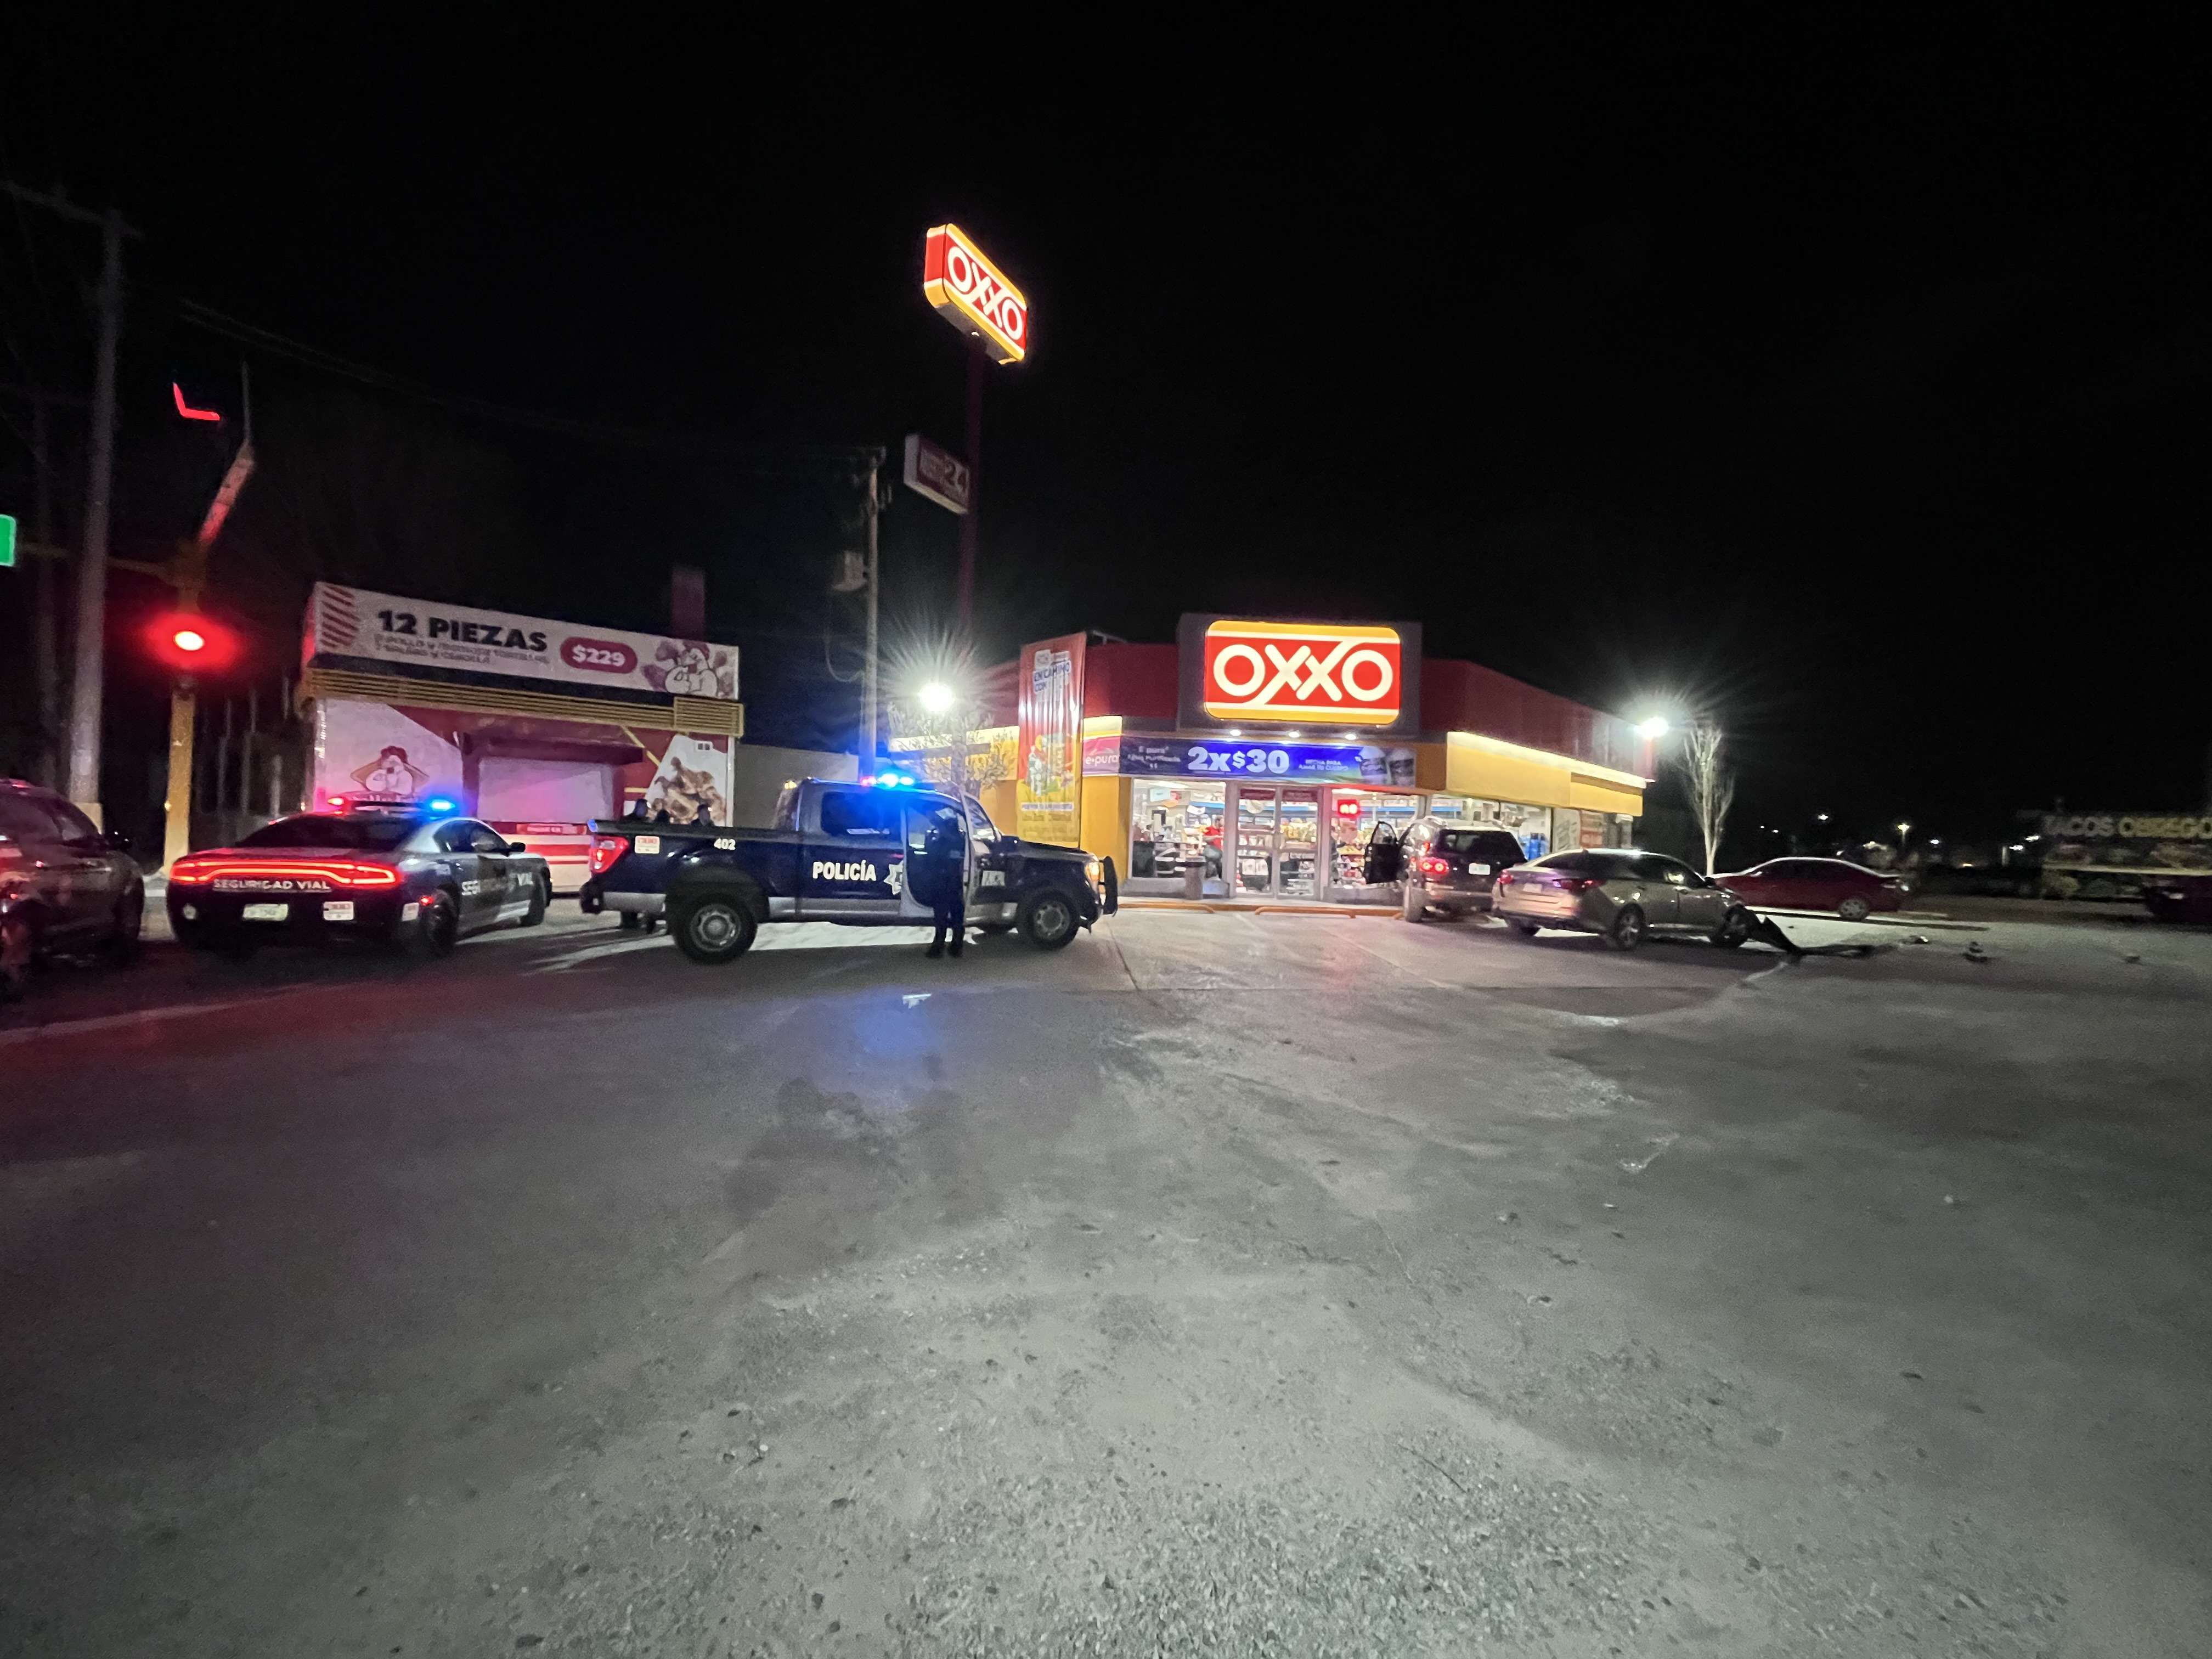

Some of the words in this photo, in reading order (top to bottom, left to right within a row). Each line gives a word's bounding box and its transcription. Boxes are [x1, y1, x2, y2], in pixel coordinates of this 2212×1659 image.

[947, 245, 1024, 341] OXXO
[377, 608, 417, 635] 12
[428, 616, 548, 652] PIEZAS
[571, 646, 627, 667] $229
[1213, 643, 1393, 704] OXXO
[1187, 747, 1290, 774] 2x$30
[713, 838, 736, 850] 402
[812, 860, 877, 882] POLICÍA
[297, 881, 331, 890] VIAL
